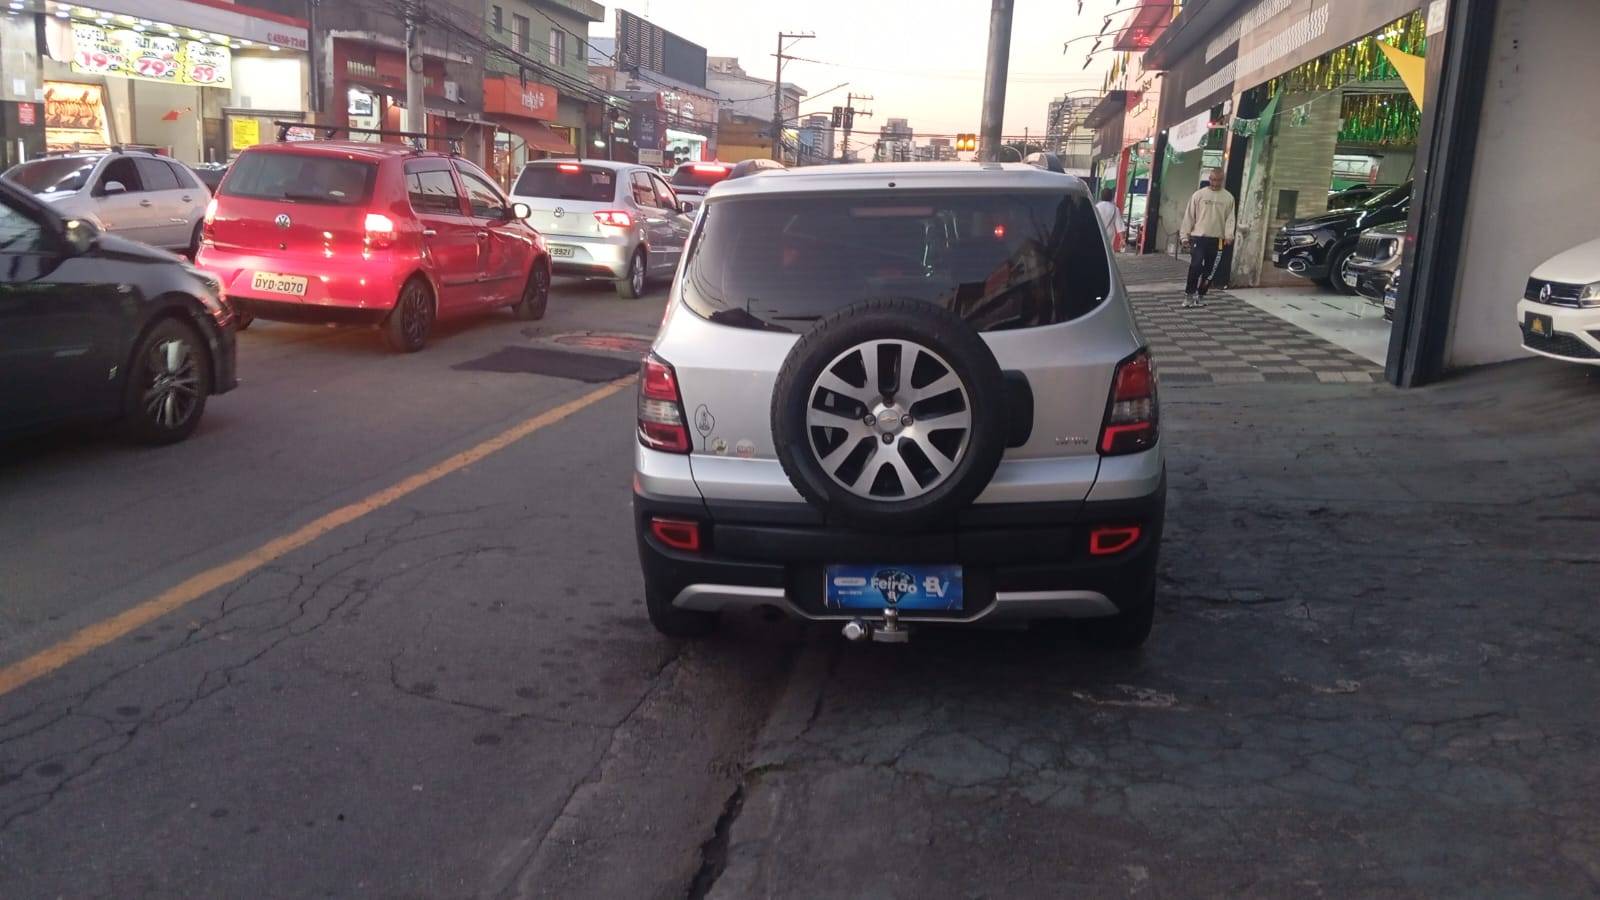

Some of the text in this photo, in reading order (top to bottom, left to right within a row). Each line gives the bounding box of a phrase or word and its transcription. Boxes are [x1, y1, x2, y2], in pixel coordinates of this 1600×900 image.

[137, 58, 165, 75] 79
[193, 65, 214, 81] 59
[871, 575, 917, 595] Feirão
